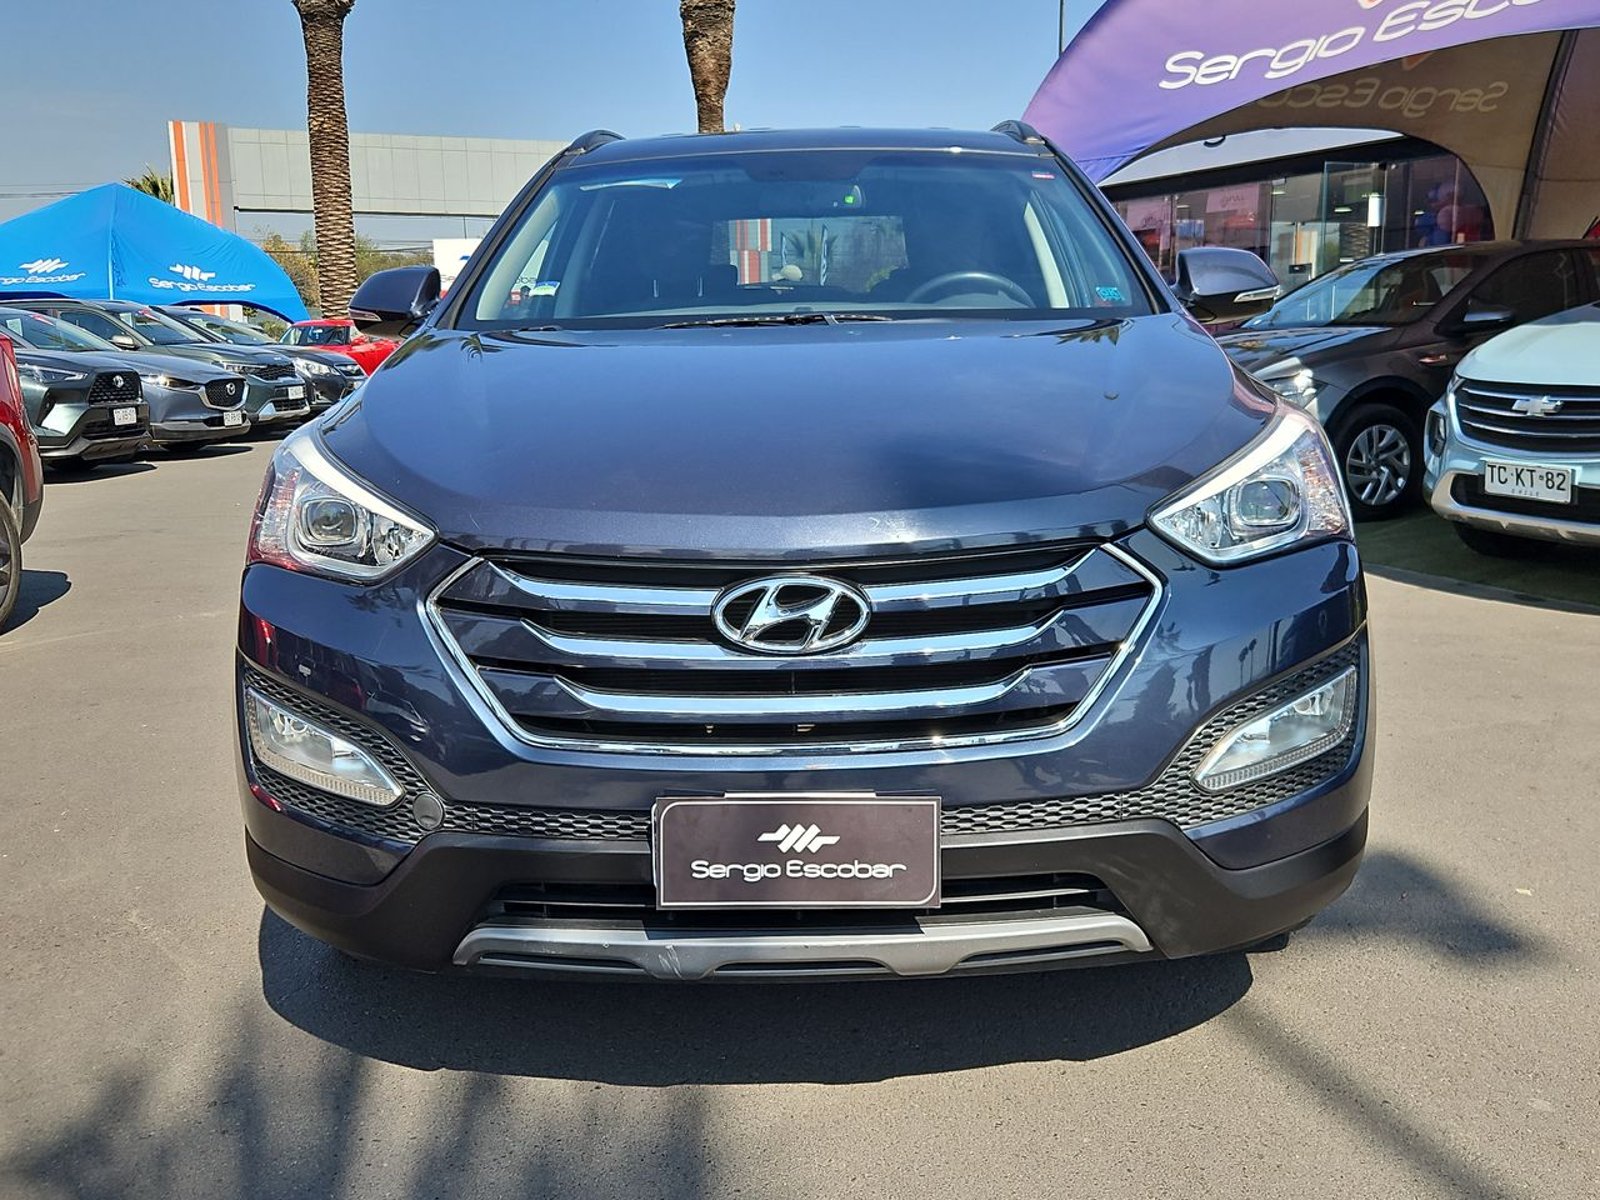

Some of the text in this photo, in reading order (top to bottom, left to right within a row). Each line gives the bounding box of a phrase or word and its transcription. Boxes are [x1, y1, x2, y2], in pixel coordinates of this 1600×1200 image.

[1158, 28, 1366, 90] Sergio
[690, 859, 907, 882] Sergio Escobar
